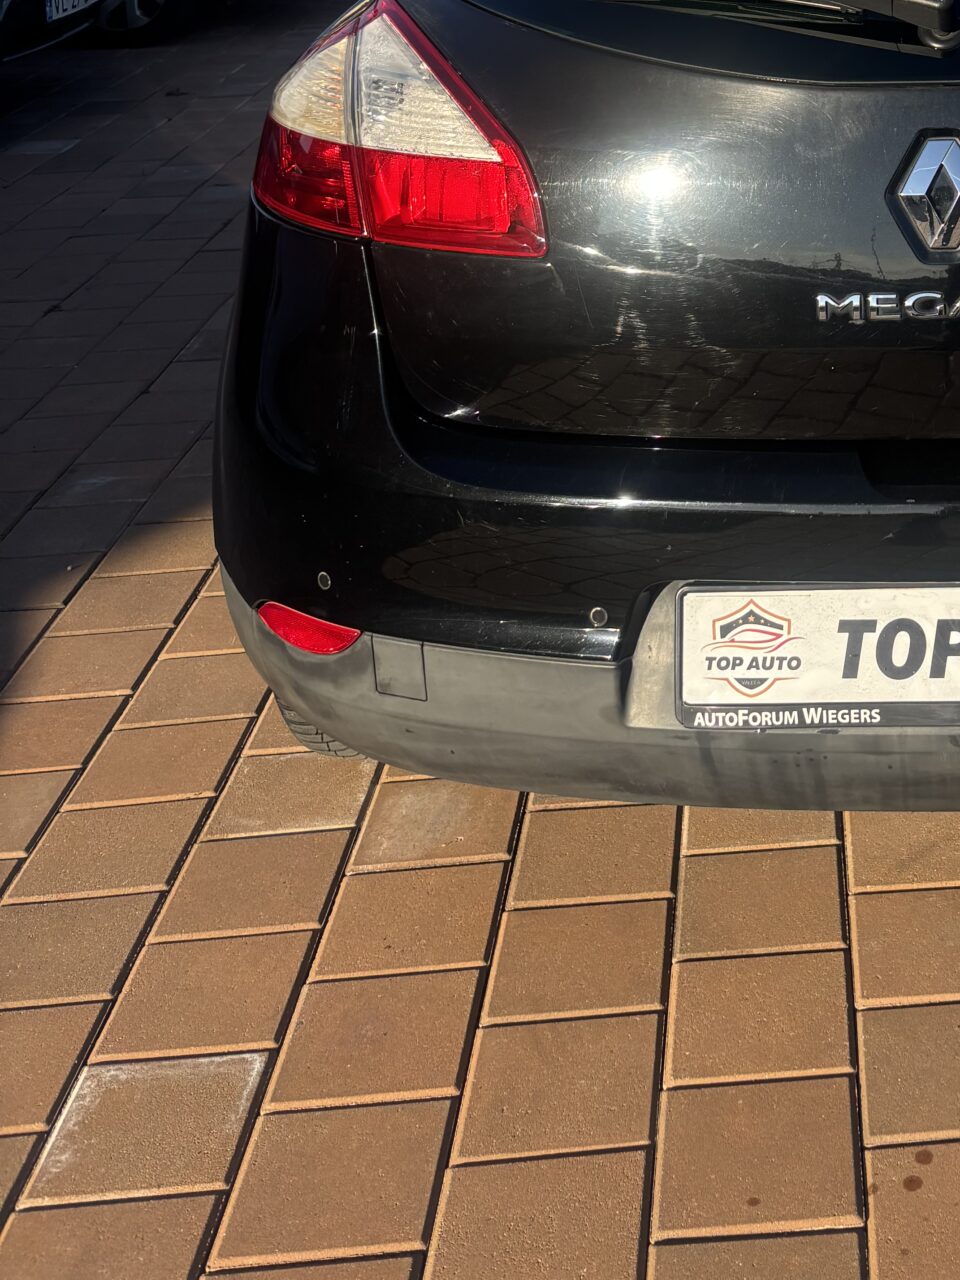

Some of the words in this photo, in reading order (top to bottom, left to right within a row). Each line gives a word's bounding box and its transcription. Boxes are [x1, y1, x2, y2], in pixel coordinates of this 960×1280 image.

[705, 656, 744, 671] TOP
[746, 656, 802, 671] AUTO
[802, 707, 881, 724] WIEGERS
